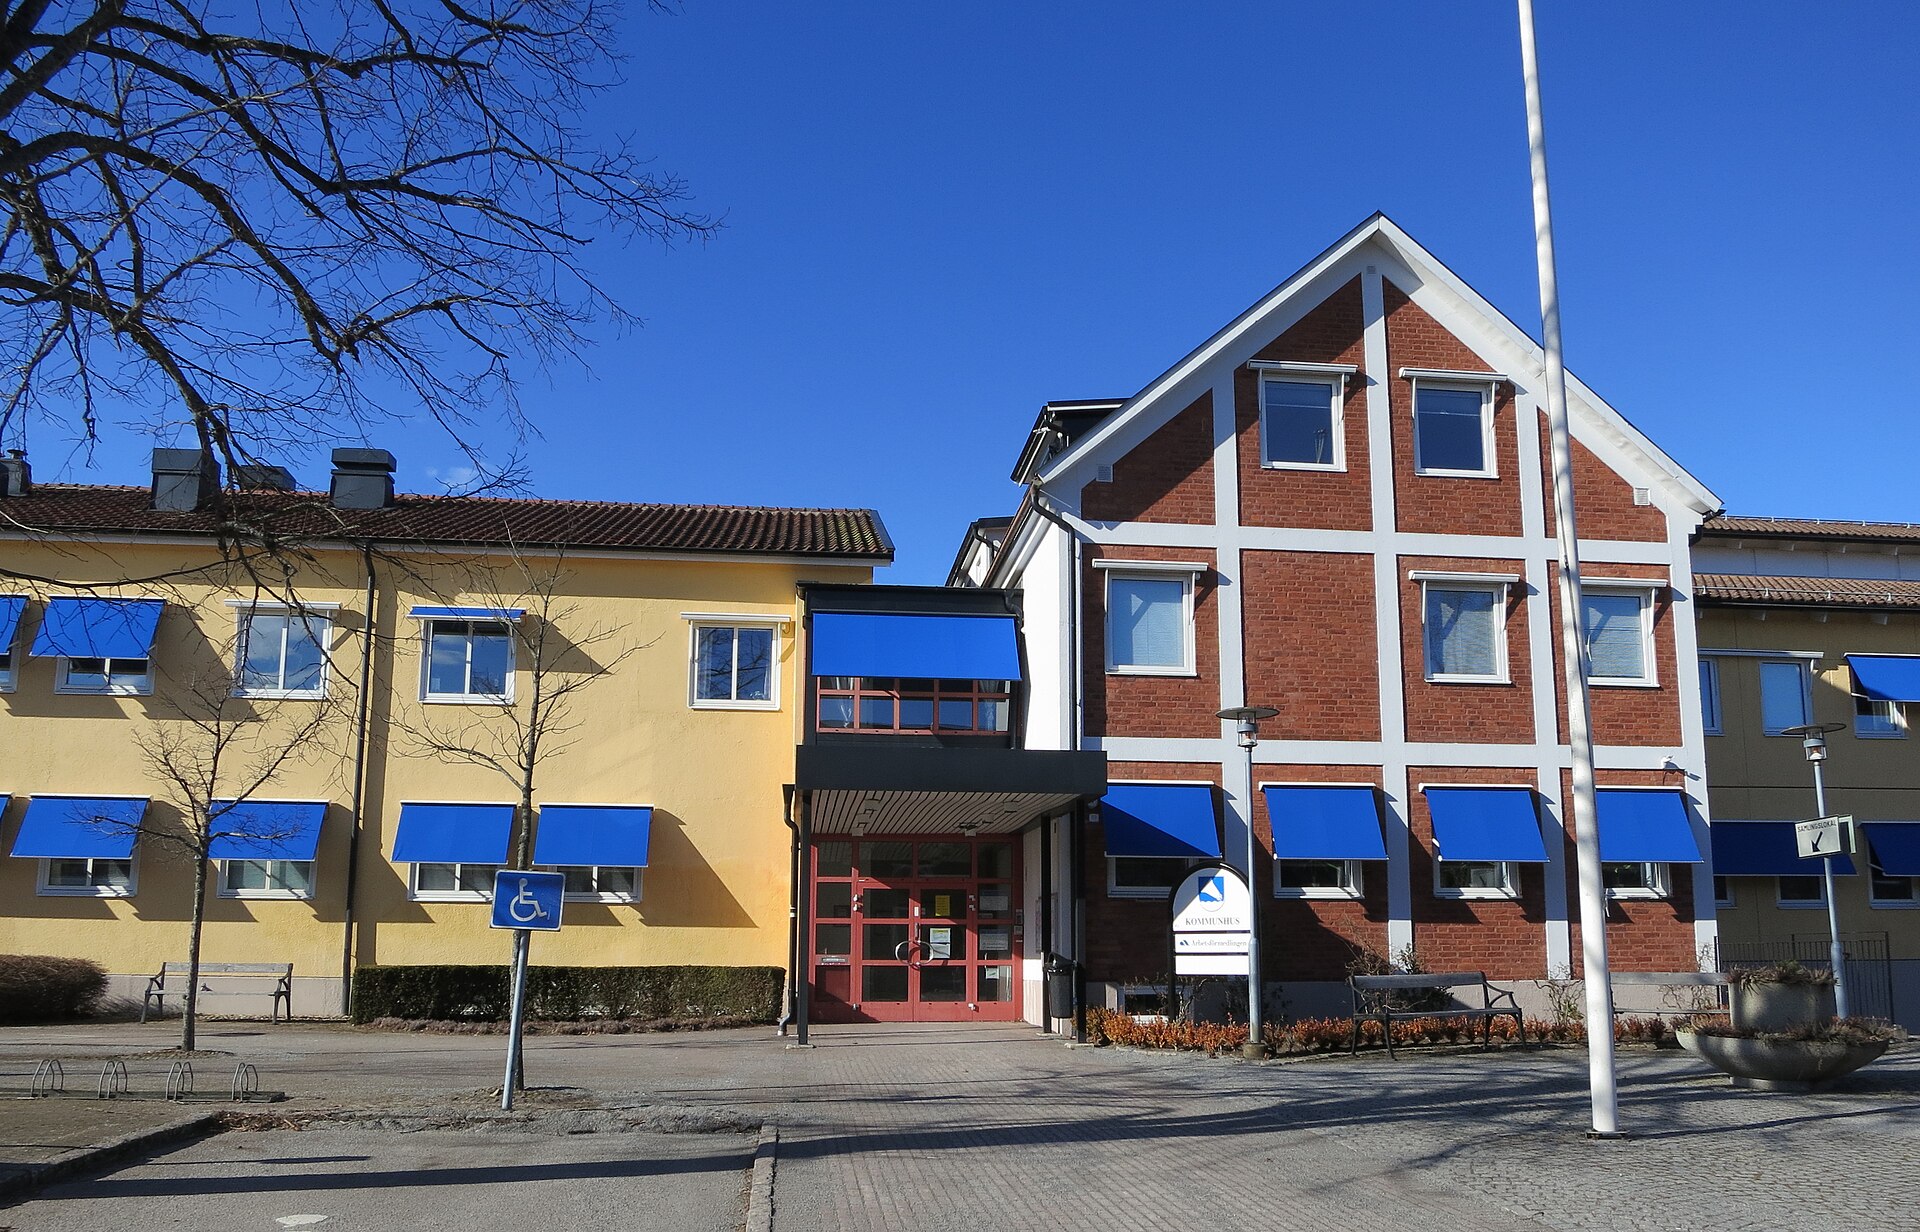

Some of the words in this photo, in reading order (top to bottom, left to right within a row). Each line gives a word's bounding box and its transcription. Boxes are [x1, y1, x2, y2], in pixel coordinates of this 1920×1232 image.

[1797, 820, 1837, 833] SAMLINGSLOKAL
[1185, 917, 1240, 926] KOMMUNHUS
[1191, 939, 1247, 948] Arbetsförmedlingen
